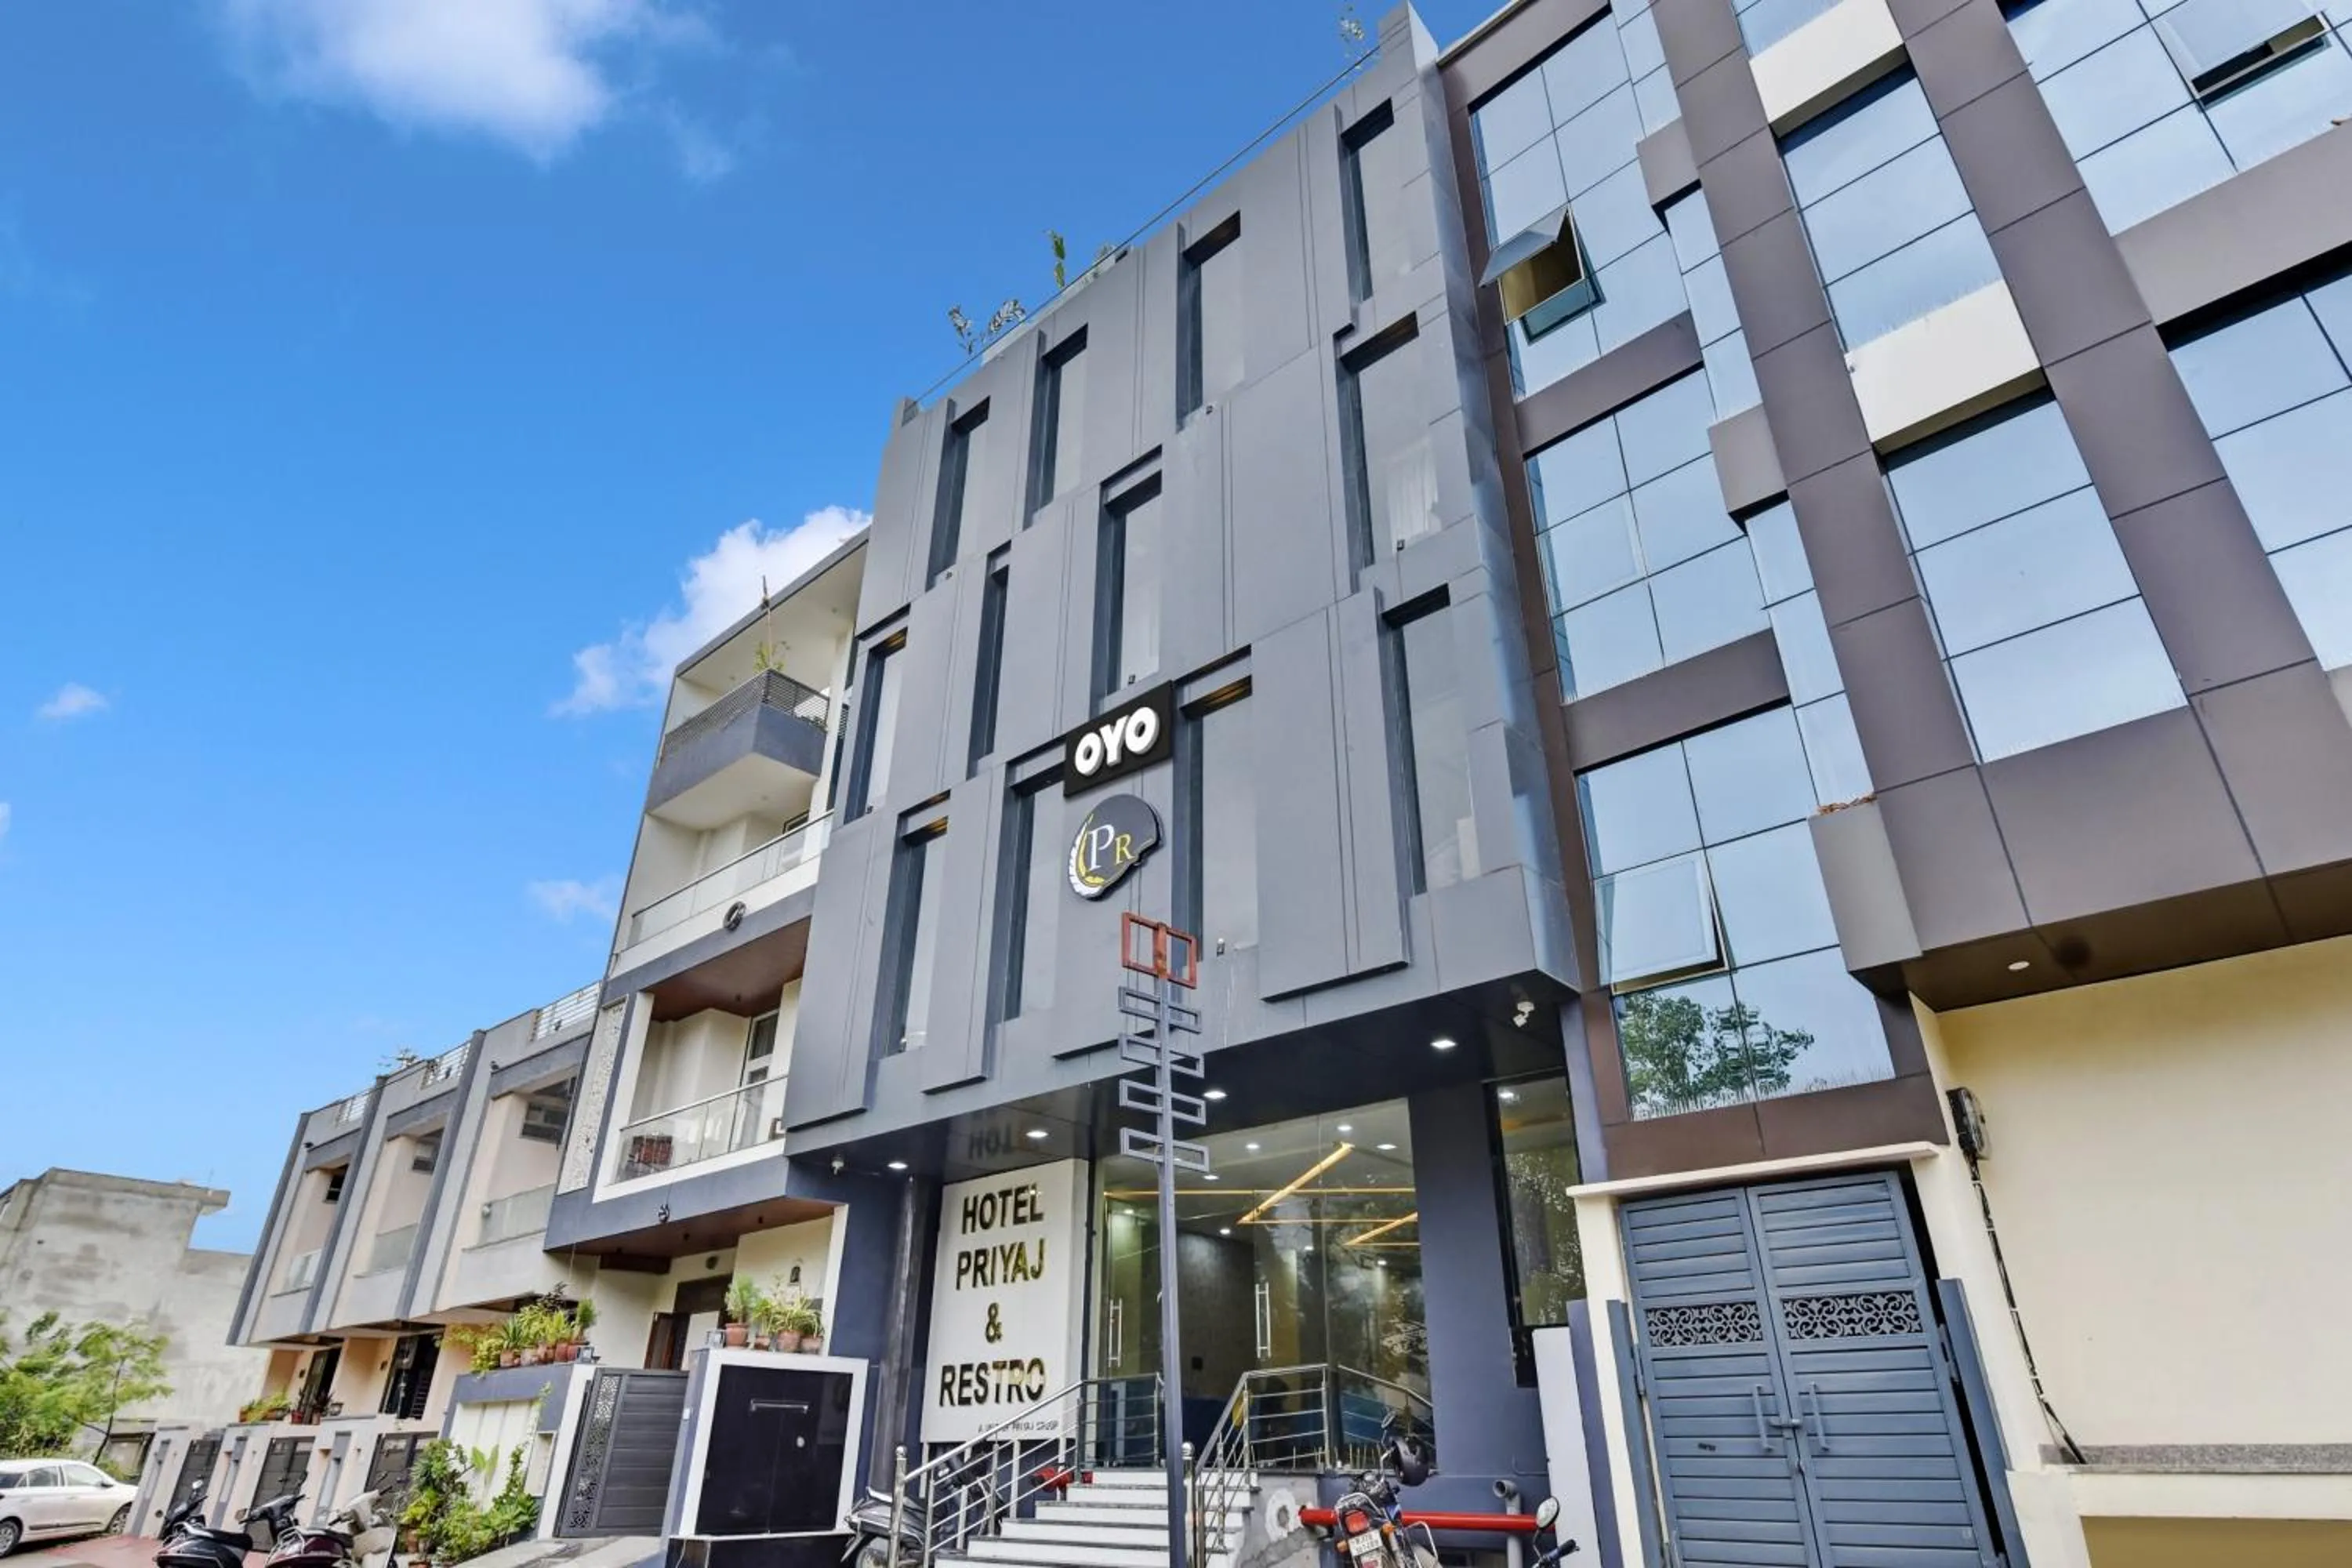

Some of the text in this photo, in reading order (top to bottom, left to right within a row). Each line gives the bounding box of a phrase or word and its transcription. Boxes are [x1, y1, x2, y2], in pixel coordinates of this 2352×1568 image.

[1075, 706, 1160, 776] OYO
[961, 1183, 1044, 1235] HOTEL
[956, 1238, 1045, 1291] PRIYAJ
[985, 1302, 1003, 1344] &
[938, 1357, 1046, 1408] RESTRO
